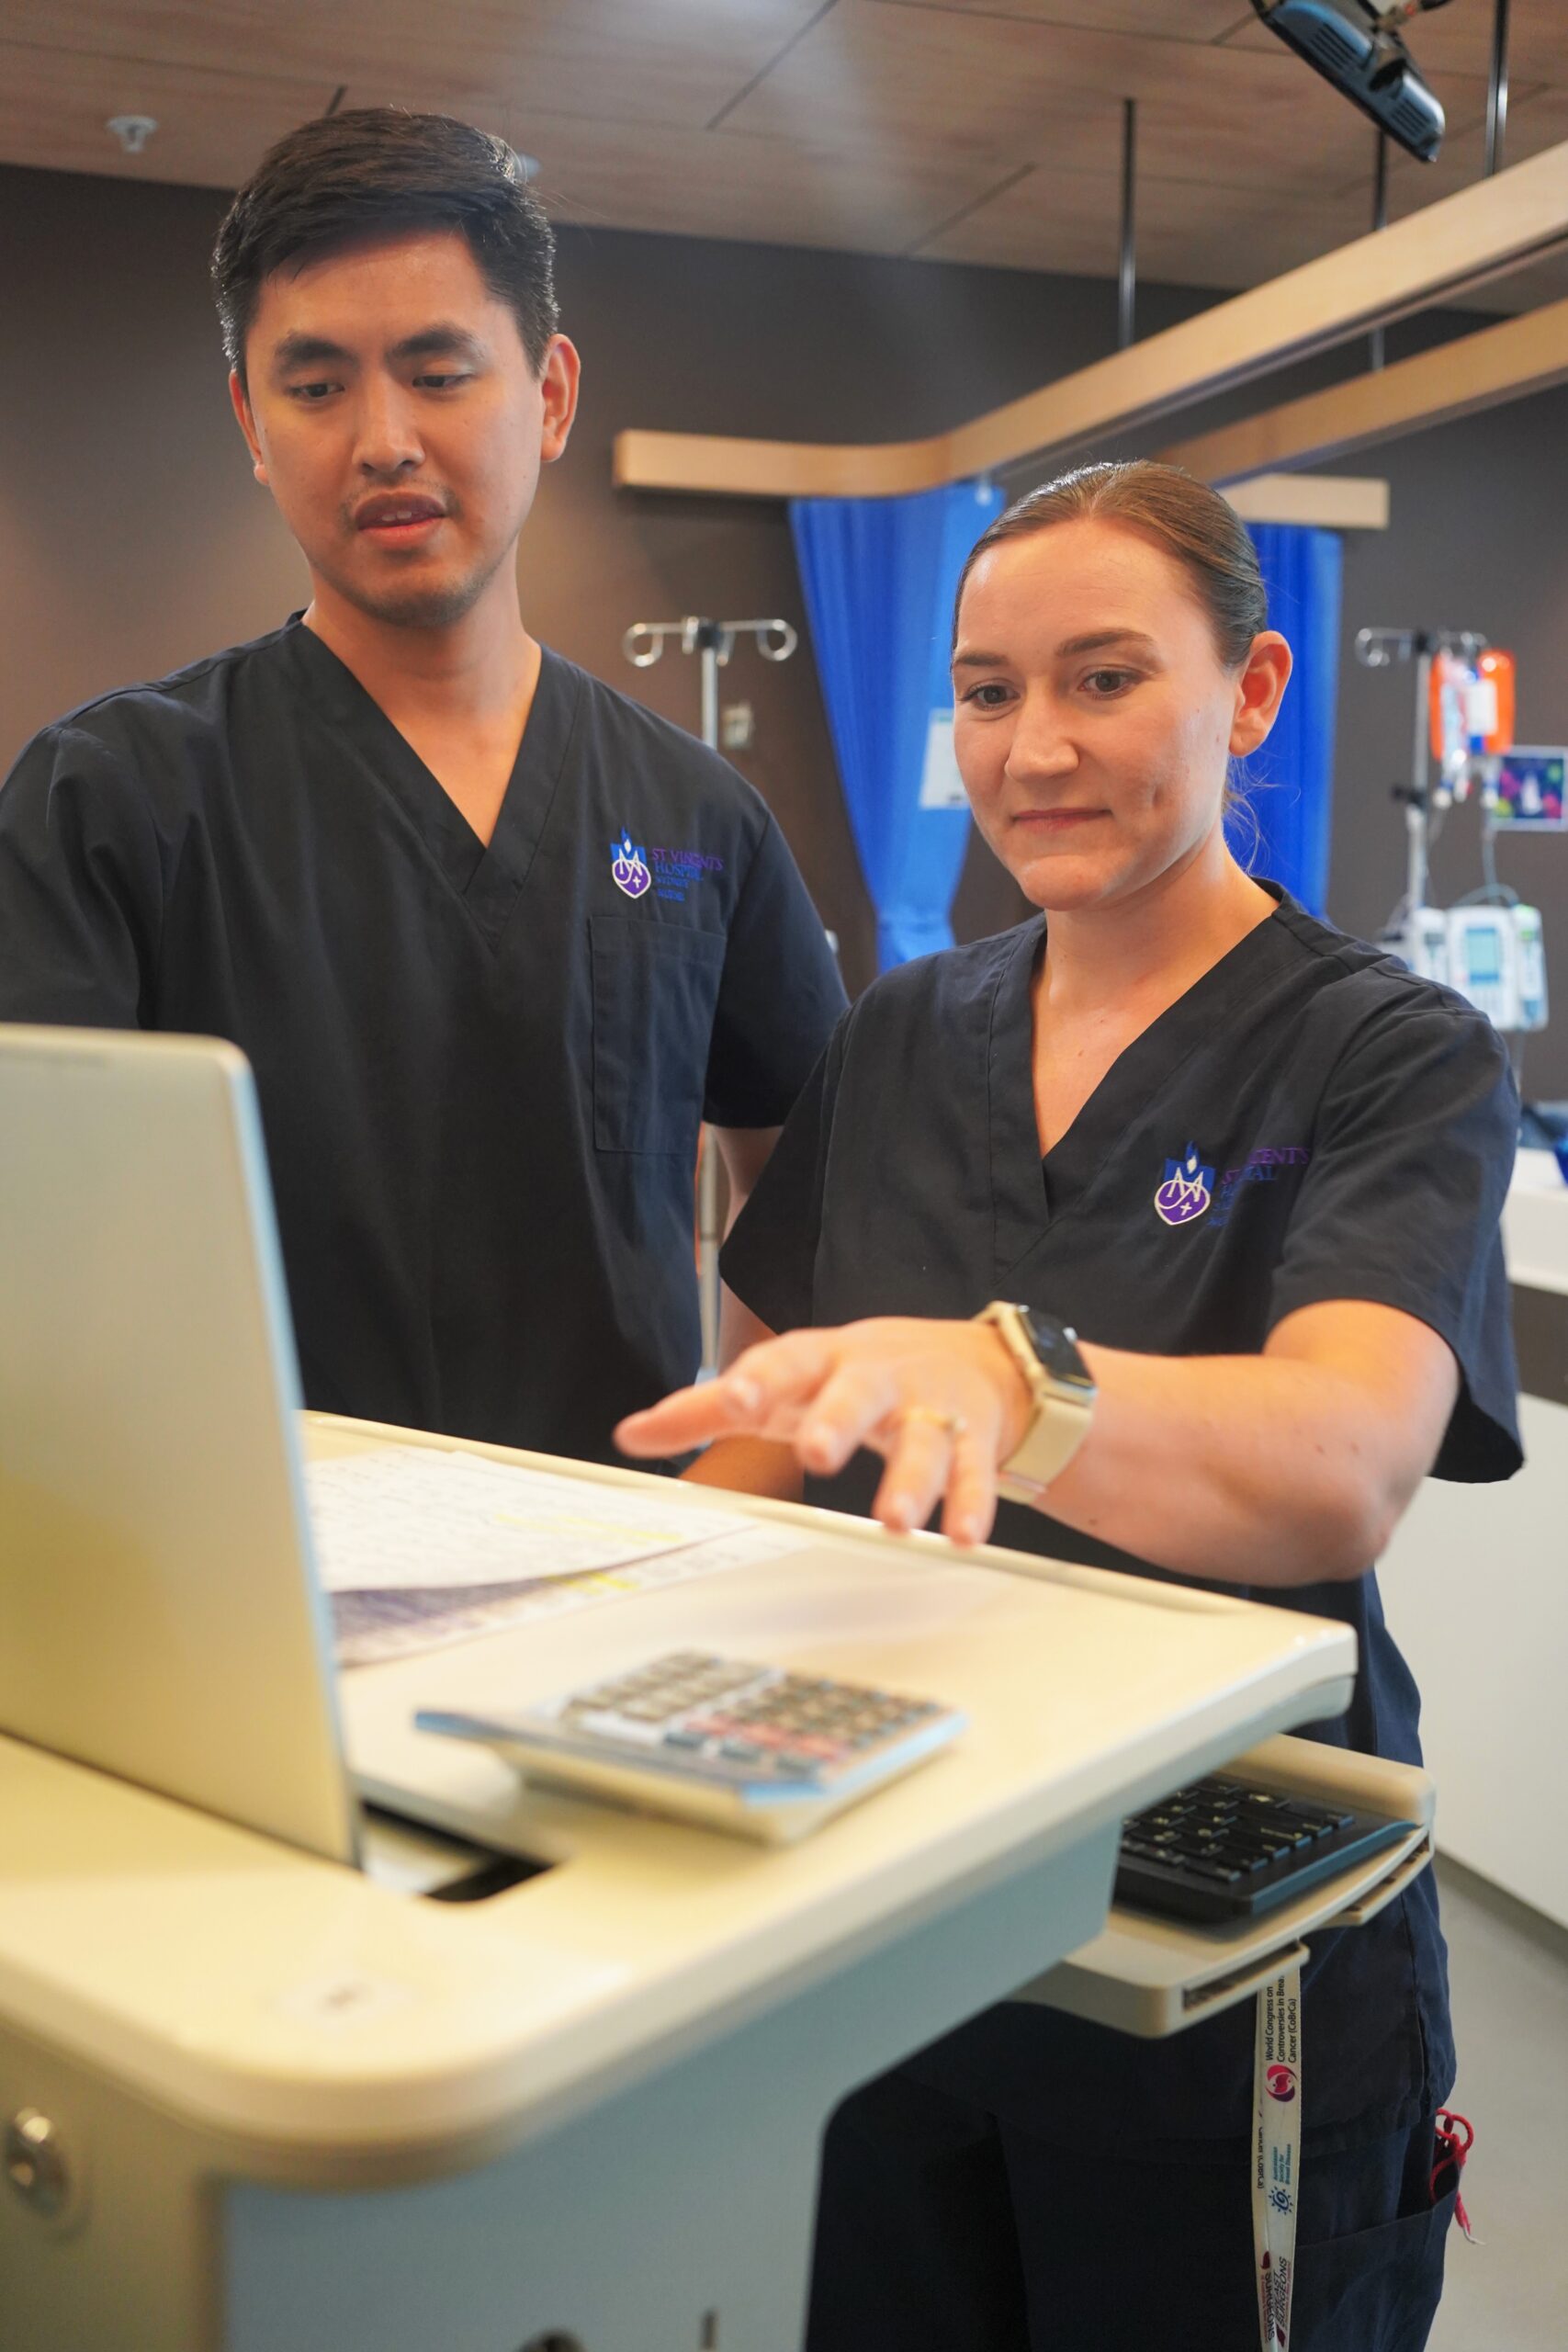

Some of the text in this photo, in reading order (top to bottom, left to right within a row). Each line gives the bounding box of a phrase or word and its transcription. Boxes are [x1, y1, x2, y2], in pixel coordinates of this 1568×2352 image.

[652, 848, 666, 861] ST
[1265, 1985, 1276, 2061] World Congress on
[1276, 1975, 1285, 2063] Controversies in Brea
[1288, 1998, 1298, 2064] Cancer (CoBrCa)
[1278, 2256, 1288, 2328] SURGEONS
